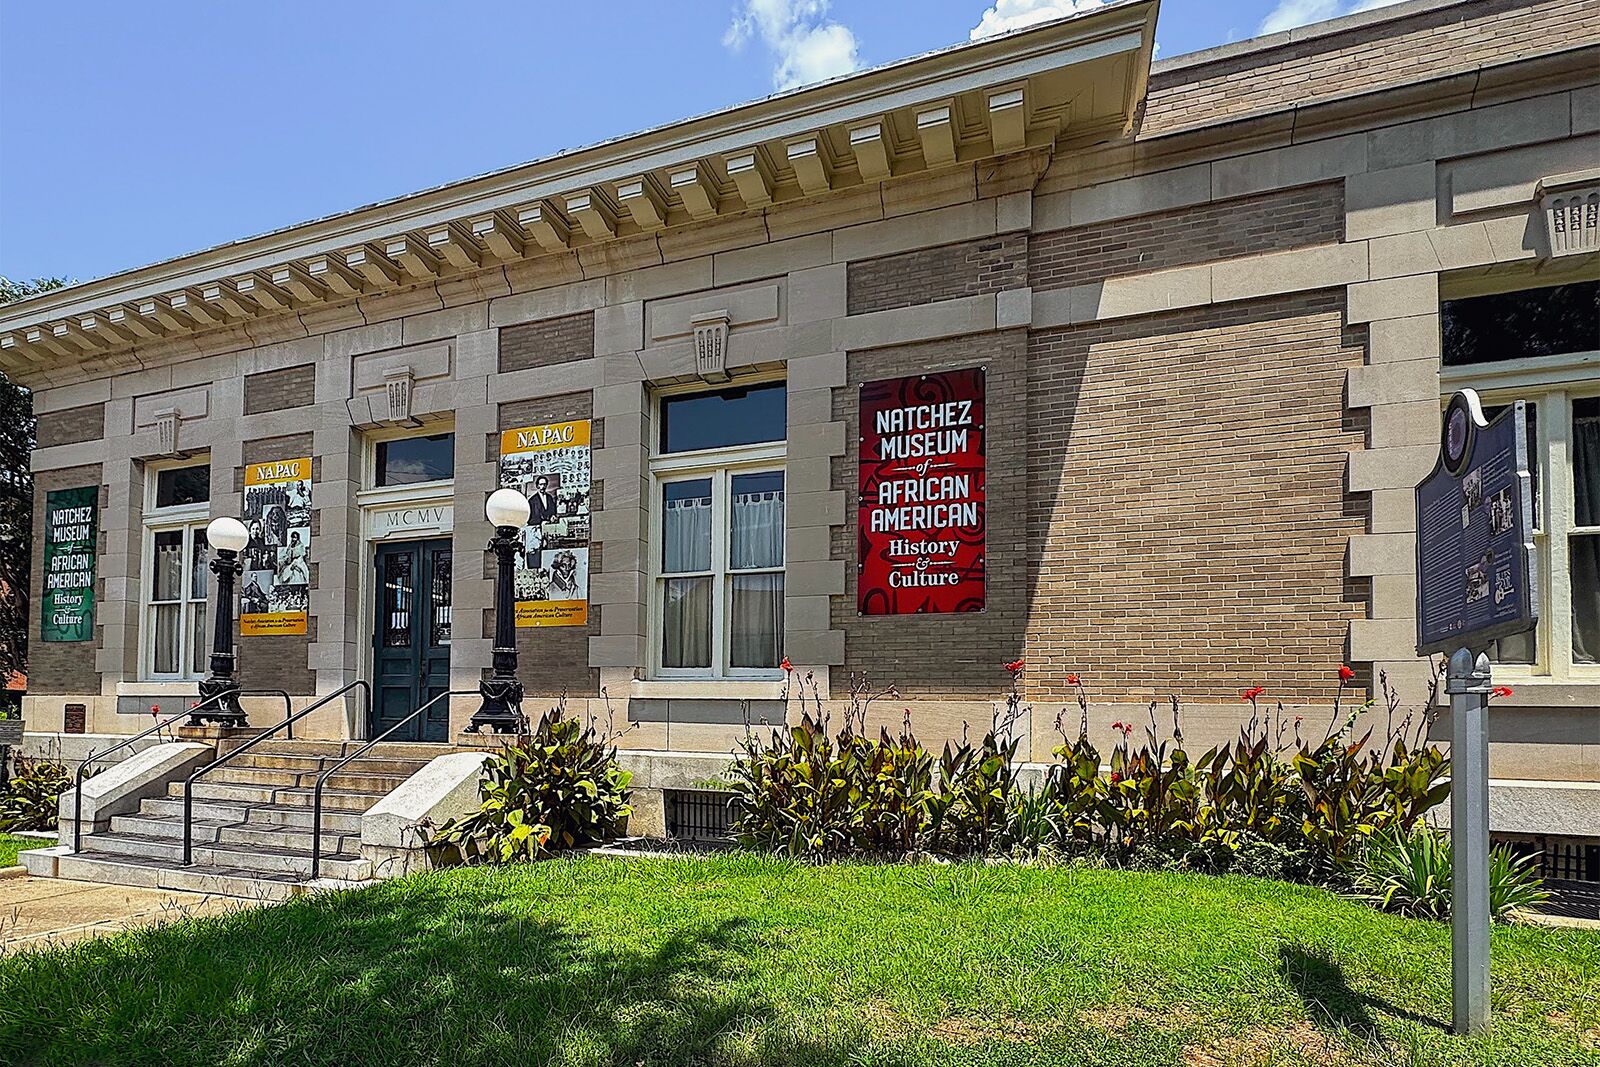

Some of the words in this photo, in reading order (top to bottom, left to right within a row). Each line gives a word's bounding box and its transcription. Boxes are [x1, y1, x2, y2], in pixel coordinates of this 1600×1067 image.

[876, 400, 972, 434] NATCHEZ
[516, 424, 574, 448] NAPAC
[880, 428, 968, 461] MUSEUM
[256, 462, 300, 481] NAPAC
[915, 459, 932, 477] of
[879, 474, 969, 505] AFRICAN
[52, 506, 92, 526] NATCHEZ
[387, 507, 444, 526] MCMV
[871, 501, 977, 533] AMERICAN
[53, 524, 90, 543] MUSEUM
[888, 538, 960, 557] History
[51, 553, 89, 572] AFRICAN
[915, 556, 931, 570] &
[47, 571, 92, 589] AMERICAN
[888, 569, 959, 588] Culture
[54, 593, 83, 606] History
[53, 613, 83, 625] Culture
